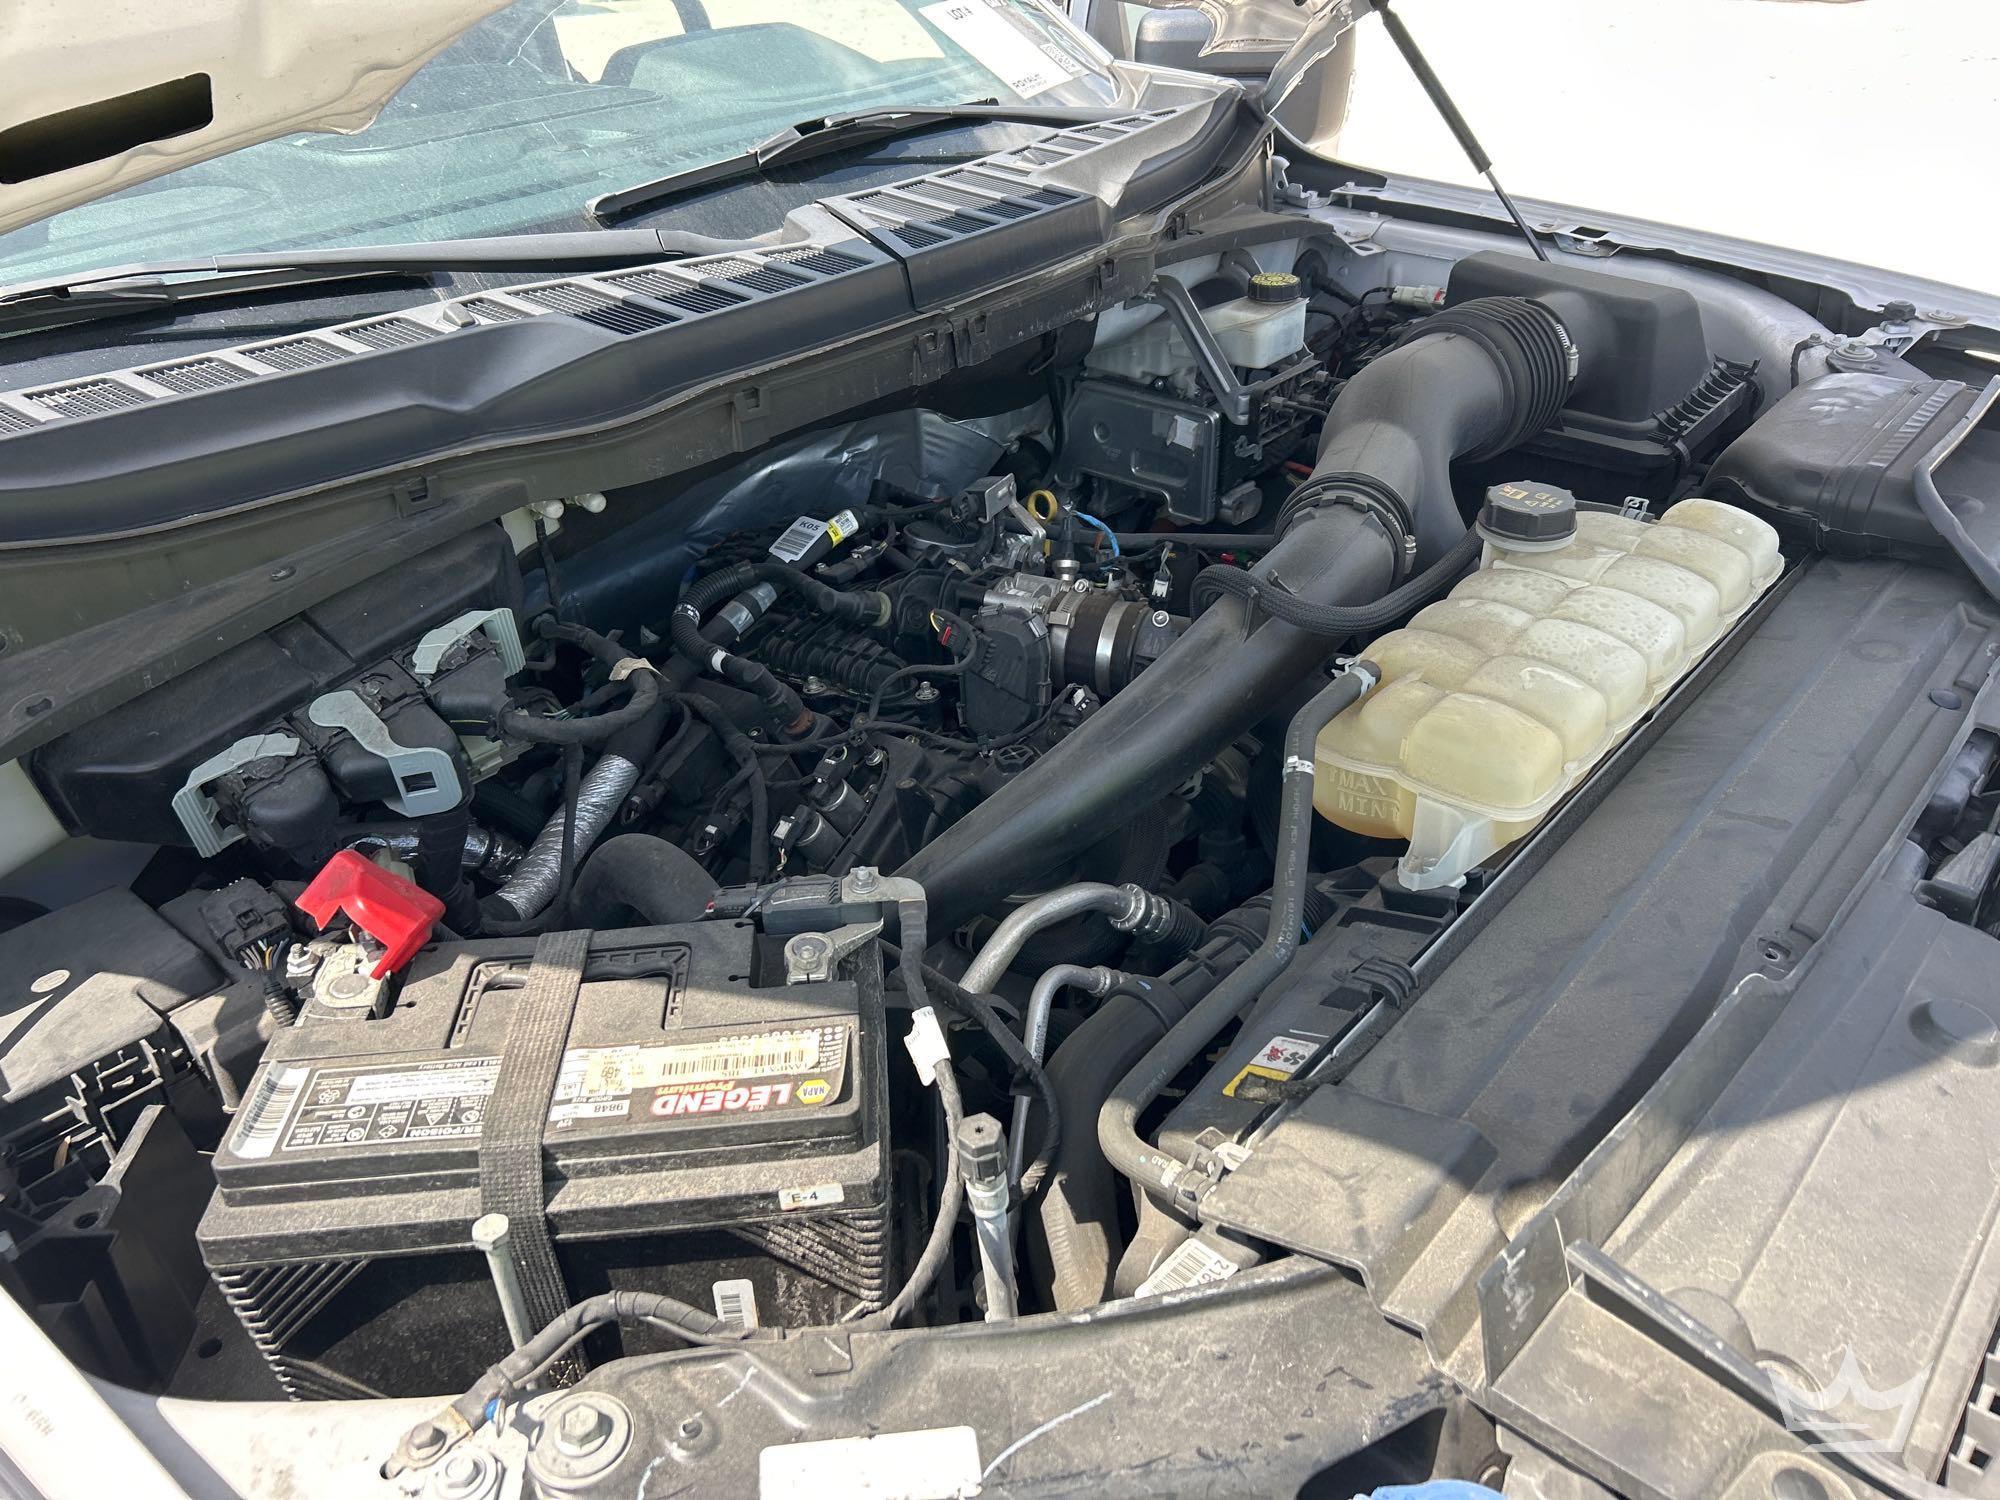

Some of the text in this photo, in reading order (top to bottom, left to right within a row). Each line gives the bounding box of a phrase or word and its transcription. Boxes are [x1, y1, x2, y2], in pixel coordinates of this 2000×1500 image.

[799, 521, 820, 531] K05
[1339, 769, 1389, 796] MAX
[1338, 793, 1387, 819] MIN
[656, 1081, 736, 1096] Premium
[803, 1086, 825, 1097] NAPA
[652, 1083, 792, 1116] LEGEND
[594, 1103, 624, 1113] 9848
